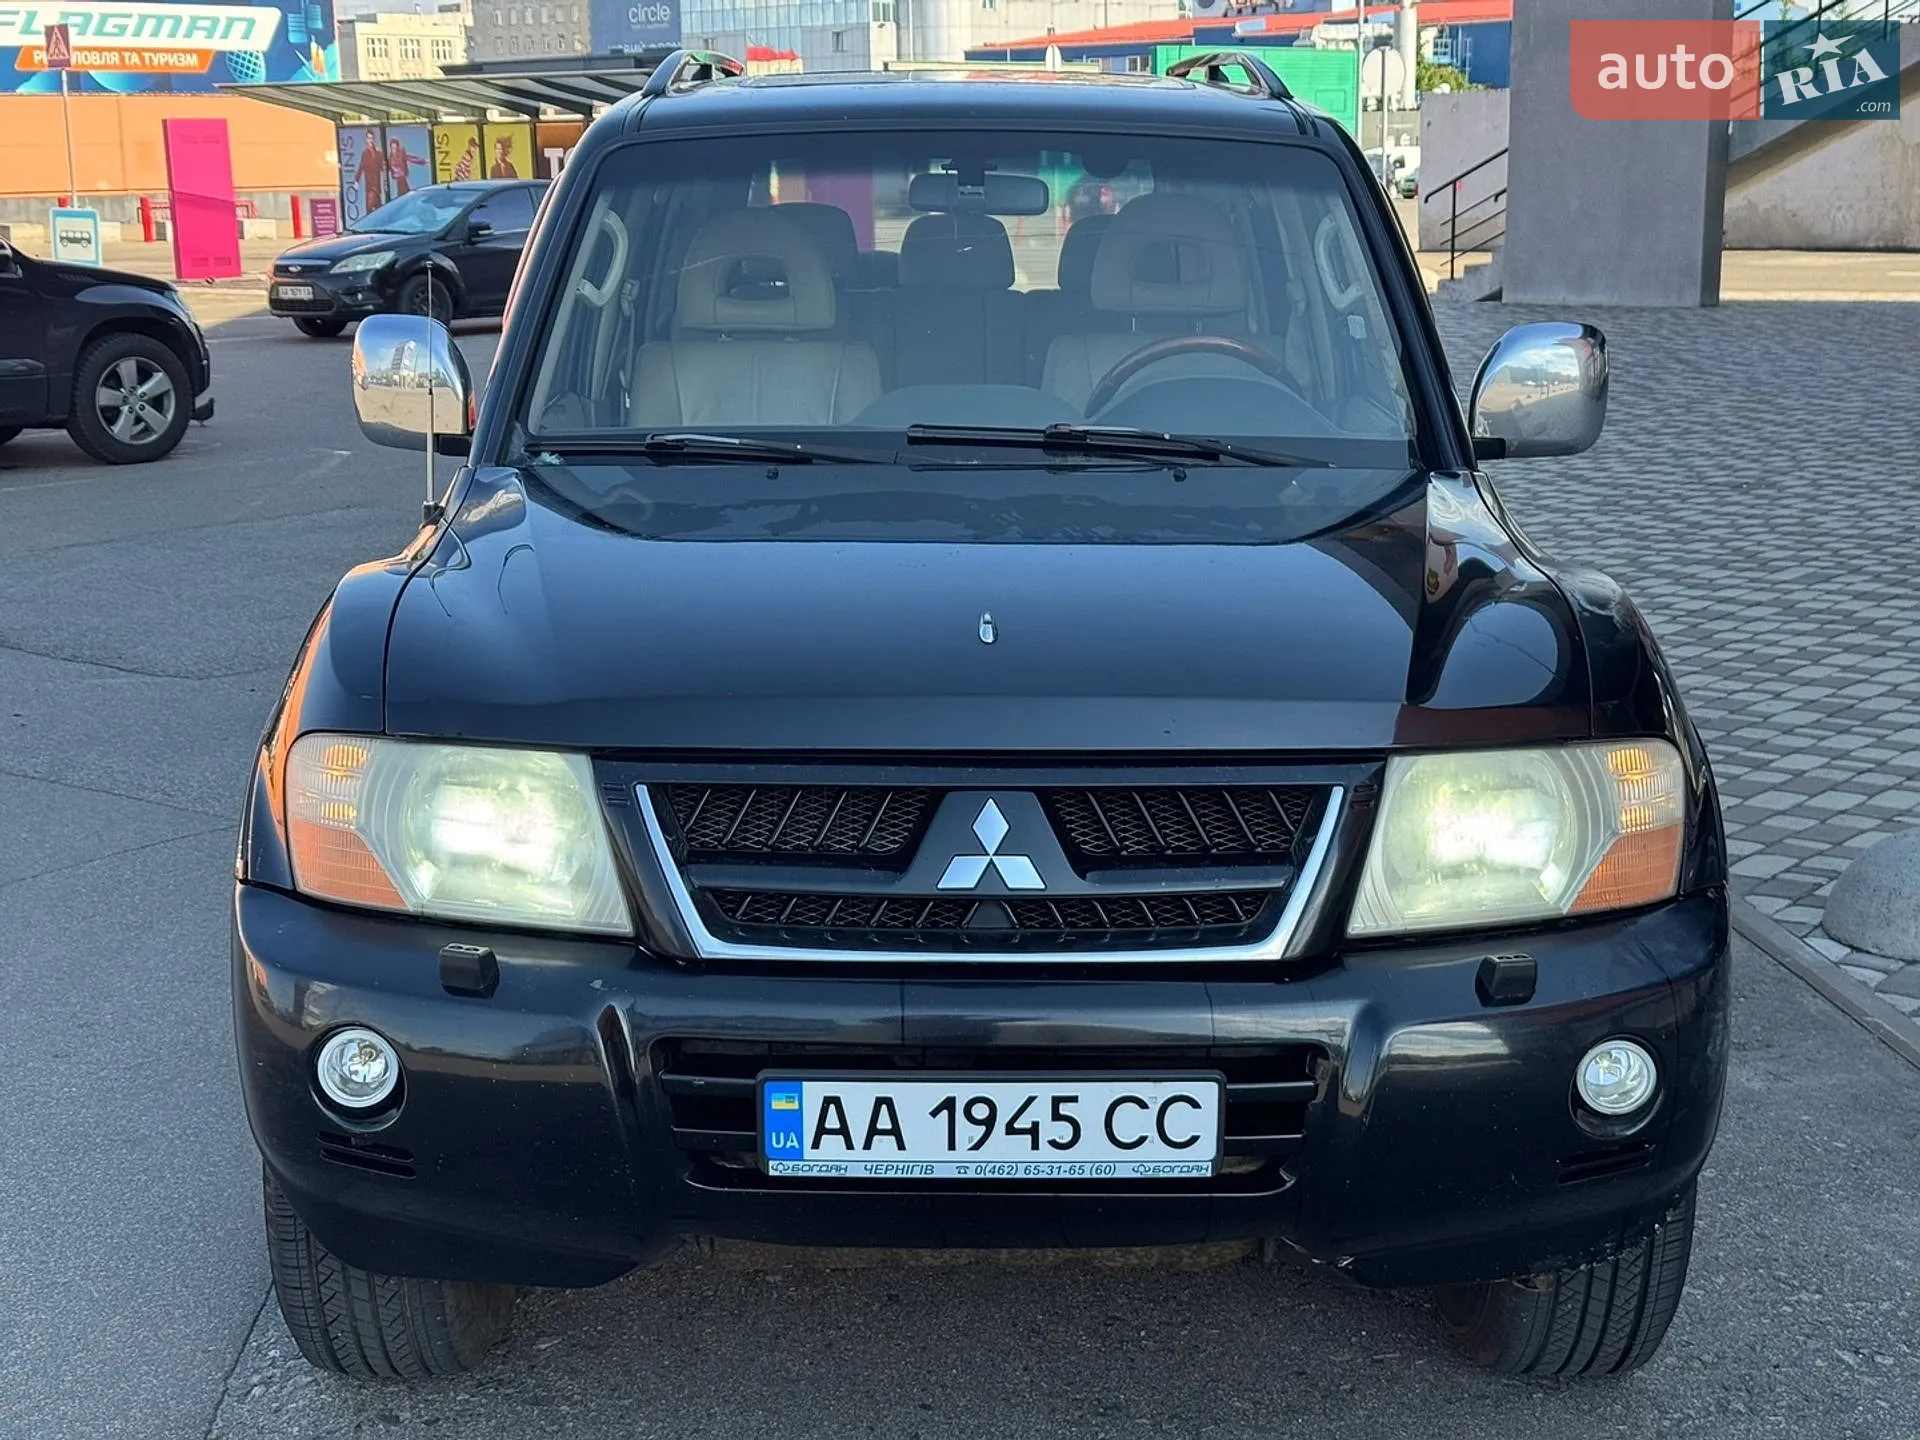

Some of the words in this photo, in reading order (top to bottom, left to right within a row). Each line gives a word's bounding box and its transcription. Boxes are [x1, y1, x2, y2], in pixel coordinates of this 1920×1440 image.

[629, 3, 670, 24] circle
[122, 51, 141, 66] ТА
[142, 51, 199, 67] ТУРИЗМ
[436, 132, 452, 184] LIN'S
[341, 135, 360, 221] COLIN'S
[811, 1095, 907, 1151] AA
[928, 1095, 1082, 1151] 1945
[1104, 1094, 1203, 1151] CC
[771, 1131, 799, 1149] UA
[790, 1164, 849, 1174] БОГДАН
[864, 1163, 936, 1175] ЧЕРНІГІВ
[975, 1163, 1019, 1177] 0(462)
[1024, 1163, 1086, 1176] 65-31-65
[1089, 1163, 1117, 1177] (60)
[1149, 1164, 1210, 1174] БОГДАН
